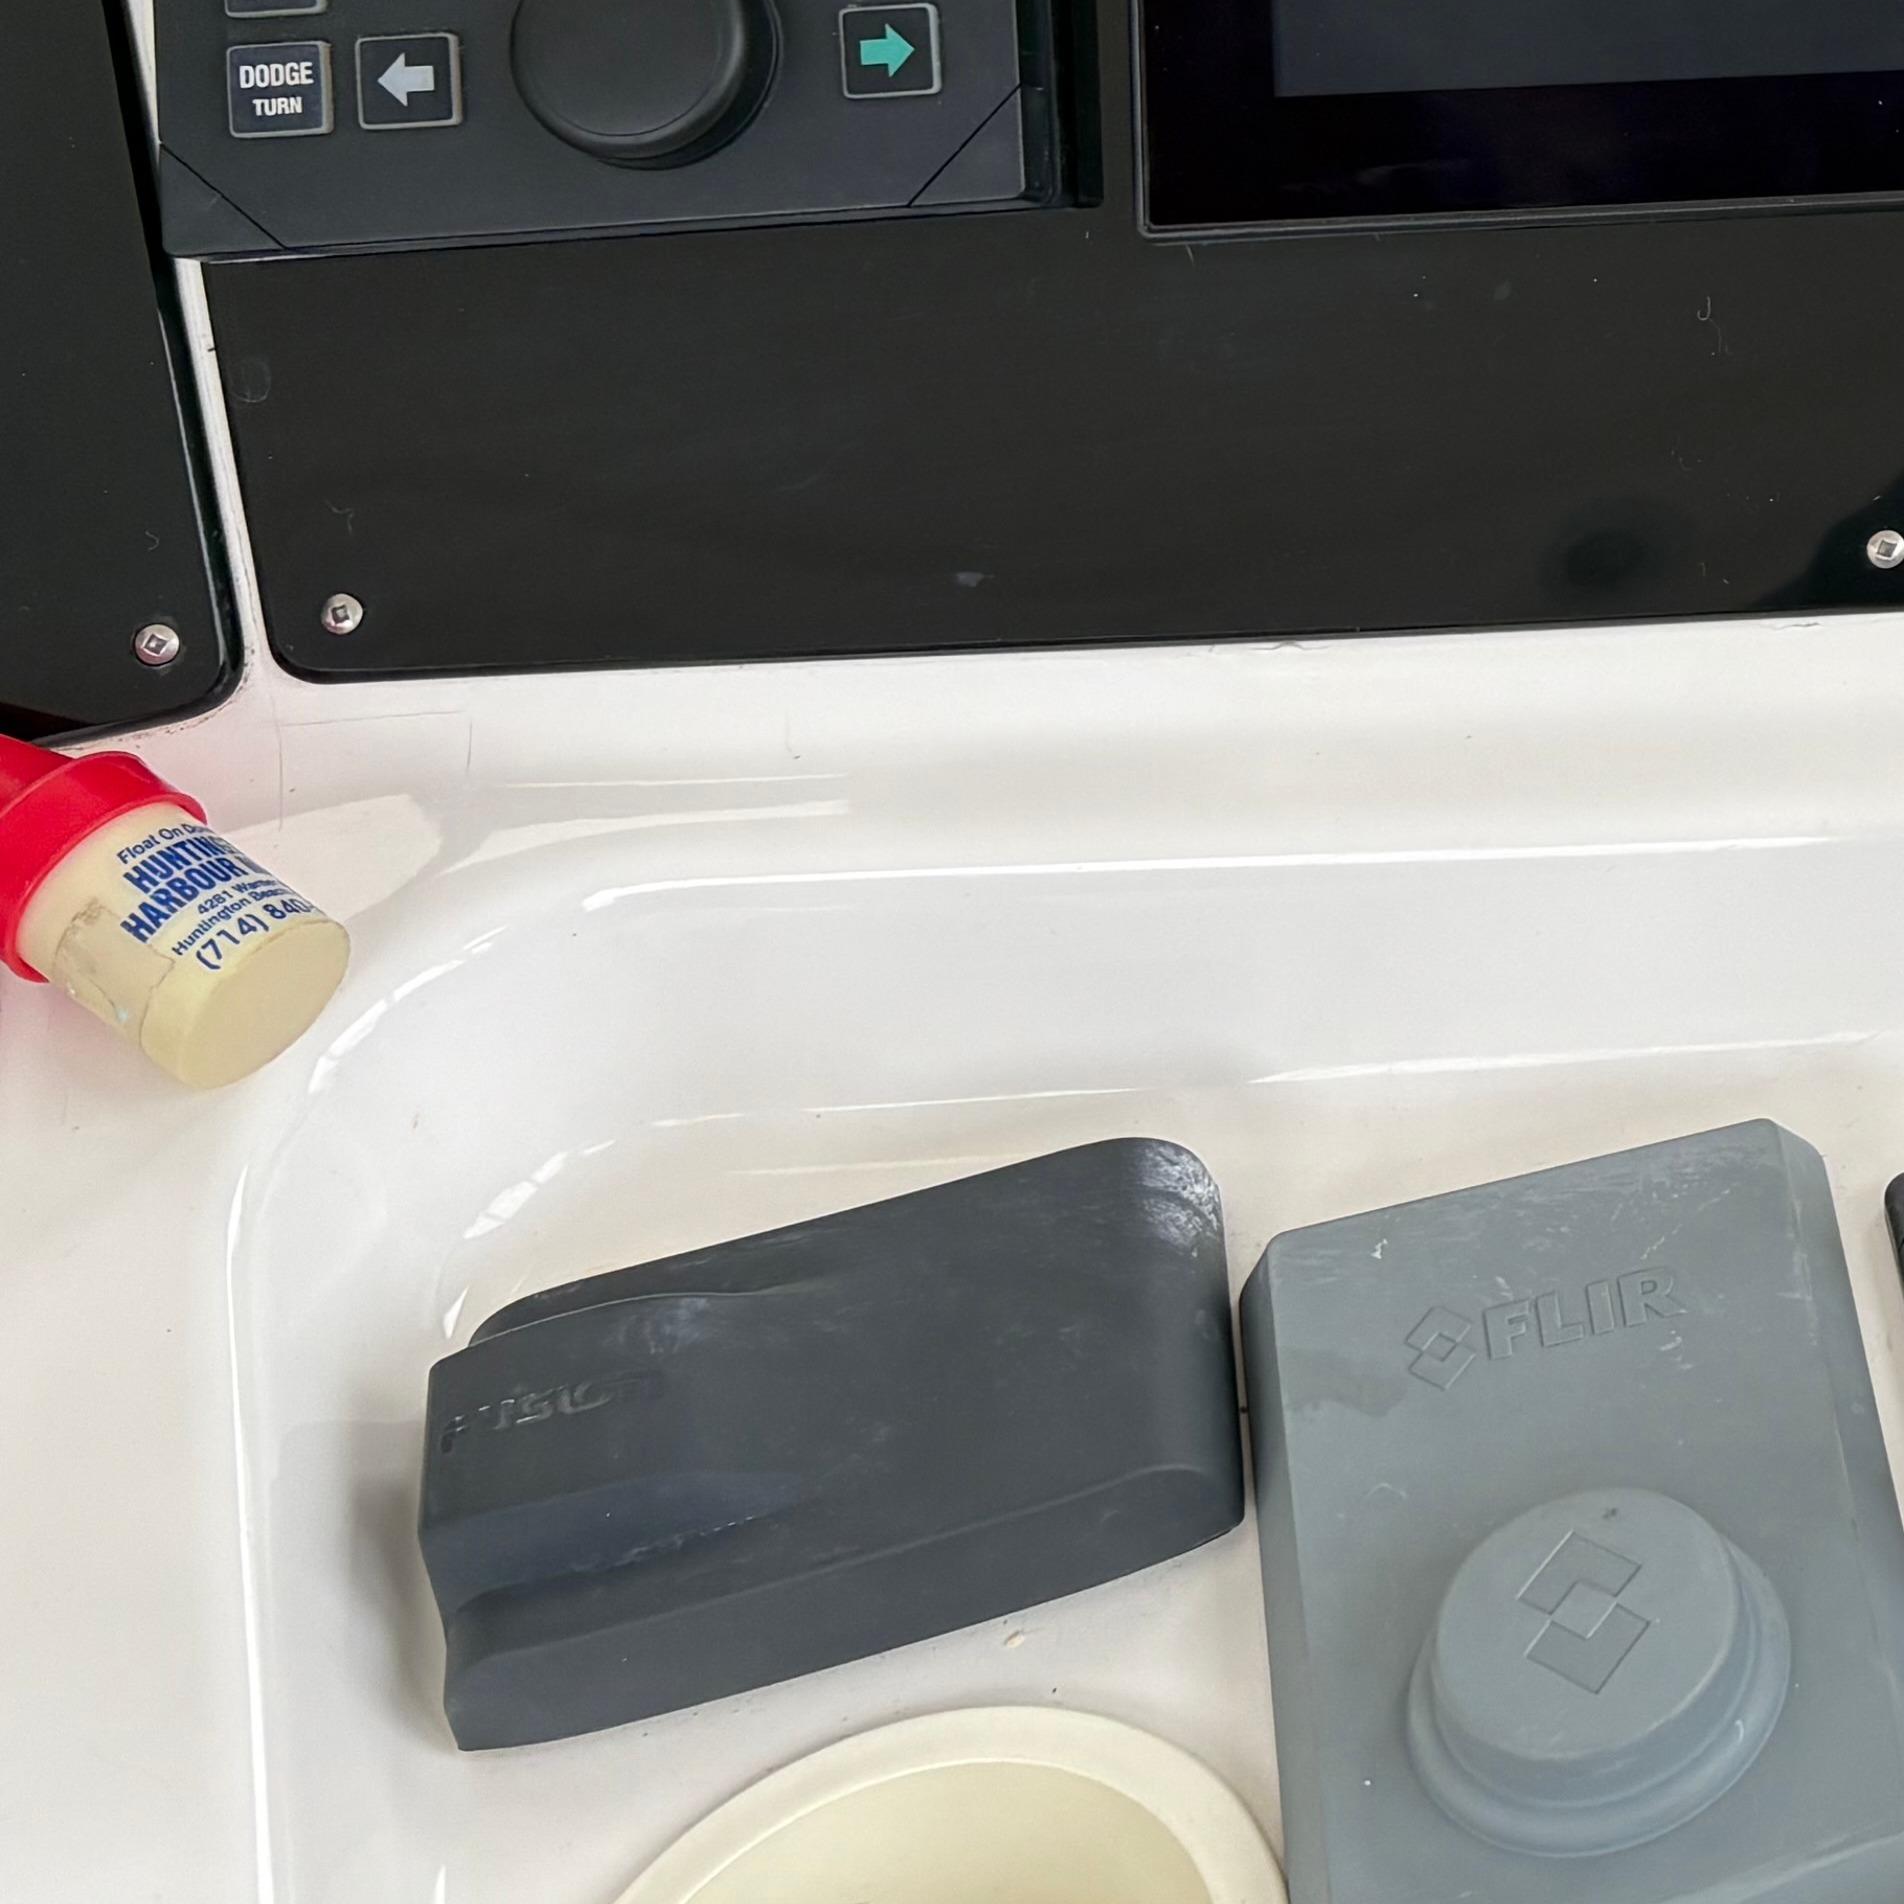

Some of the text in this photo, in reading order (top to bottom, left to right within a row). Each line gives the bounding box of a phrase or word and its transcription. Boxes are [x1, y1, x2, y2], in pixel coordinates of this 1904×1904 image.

[238, 61, 315, 89] DODGE
[252, 96, 303, 117] TURN
[116, 834, 161, 866] Float
[158, 826, 185, 842] On
[119, 856, 250, 944] HARBOUR
[171, 897, 252, 956] Huntington
[195, 912, 270, 971] (714)
[1482, 1265, 1690, 1362] FLIR
